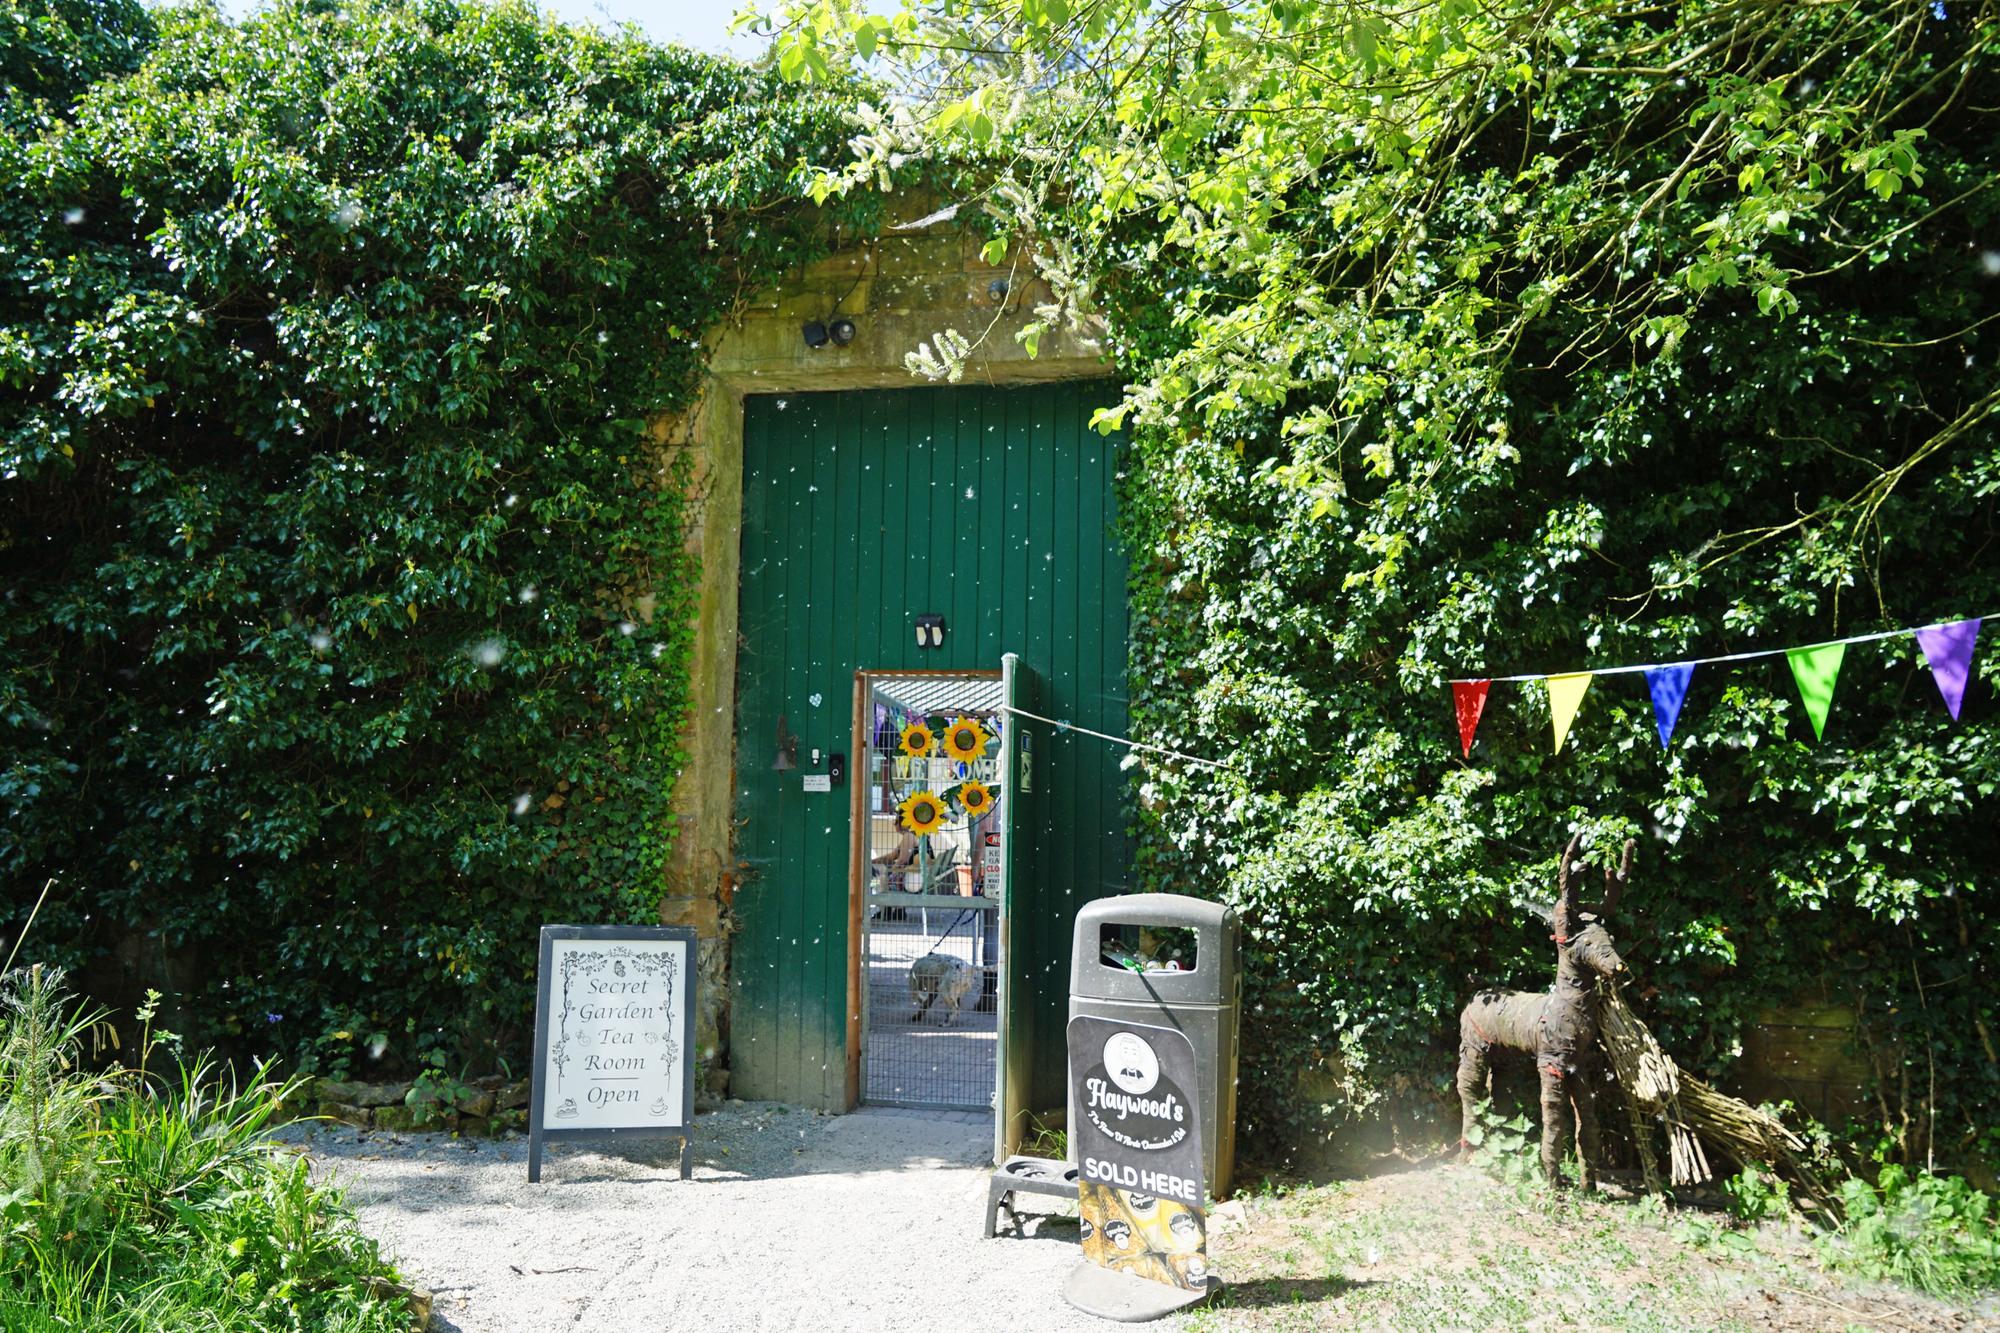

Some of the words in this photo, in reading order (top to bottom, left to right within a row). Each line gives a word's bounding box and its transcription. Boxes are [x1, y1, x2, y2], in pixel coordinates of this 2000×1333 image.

[586, 978, 650, 995] Secret
[579, 1001, 655, 1023] Garden
[597, 1028, 634, 1045] Tea
[584, 1054, 646, 1071] Room
[587, 1086, 641, 1109] Open
[1086, 1077, 1184, 1122] Haywood's
[1085, 1157, 1138, 1187] SOLD
[1141, 1169, 1197, 1200] HERE
